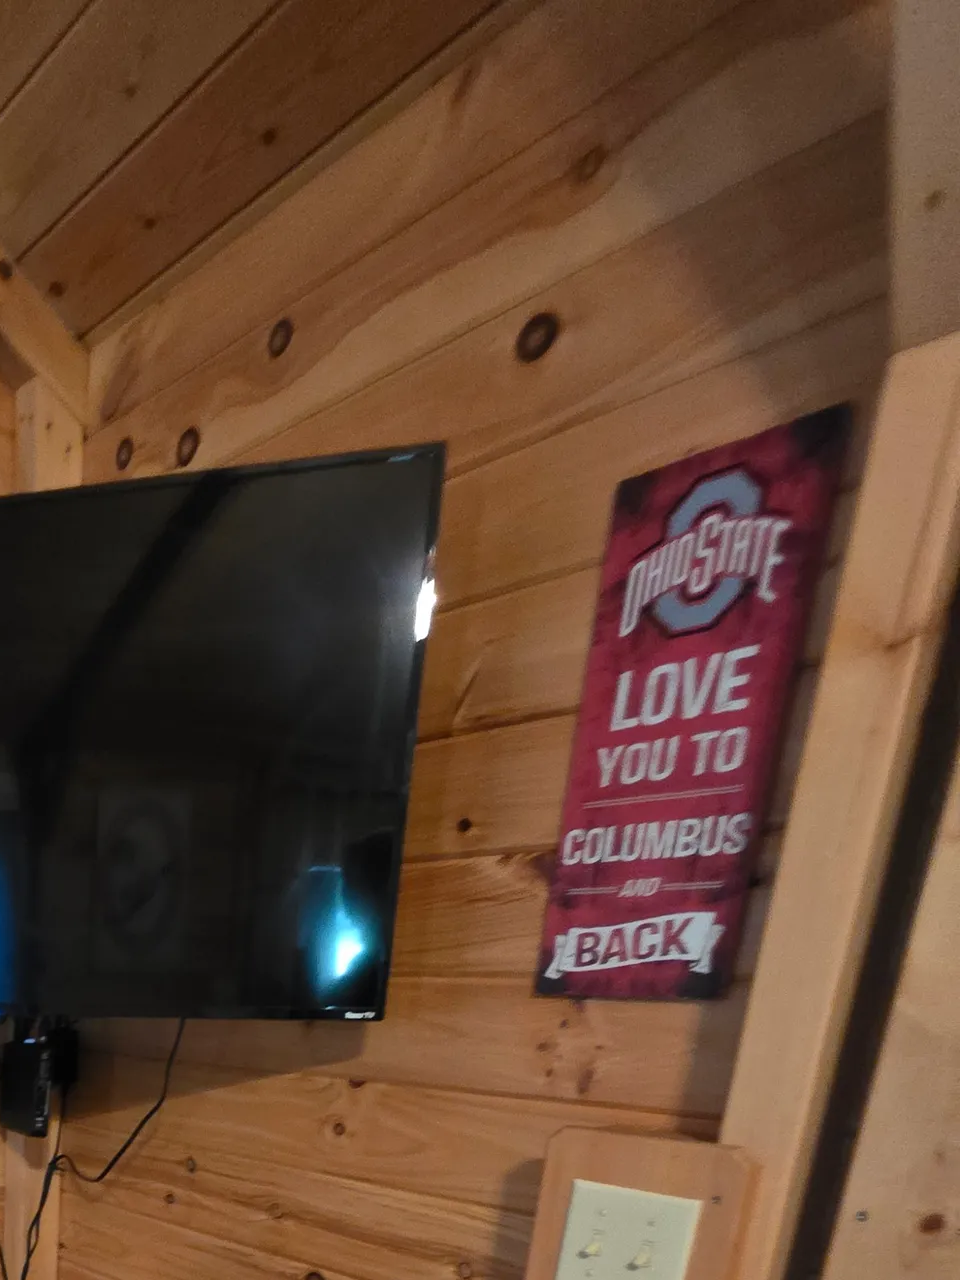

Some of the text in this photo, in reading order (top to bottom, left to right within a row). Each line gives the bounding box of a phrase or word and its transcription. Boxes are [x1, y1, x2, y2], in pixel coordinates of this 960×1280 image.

[618, 513, 793, 638] OHIO STATE
[609, 644, 761, 732] LOVE
[596, 726, 749, 788] YOU TO
[562, 812, 753, 866] COLUMBUS
[617, 877, 663, 898] AND
[573, 917, 695, 967] BACK
